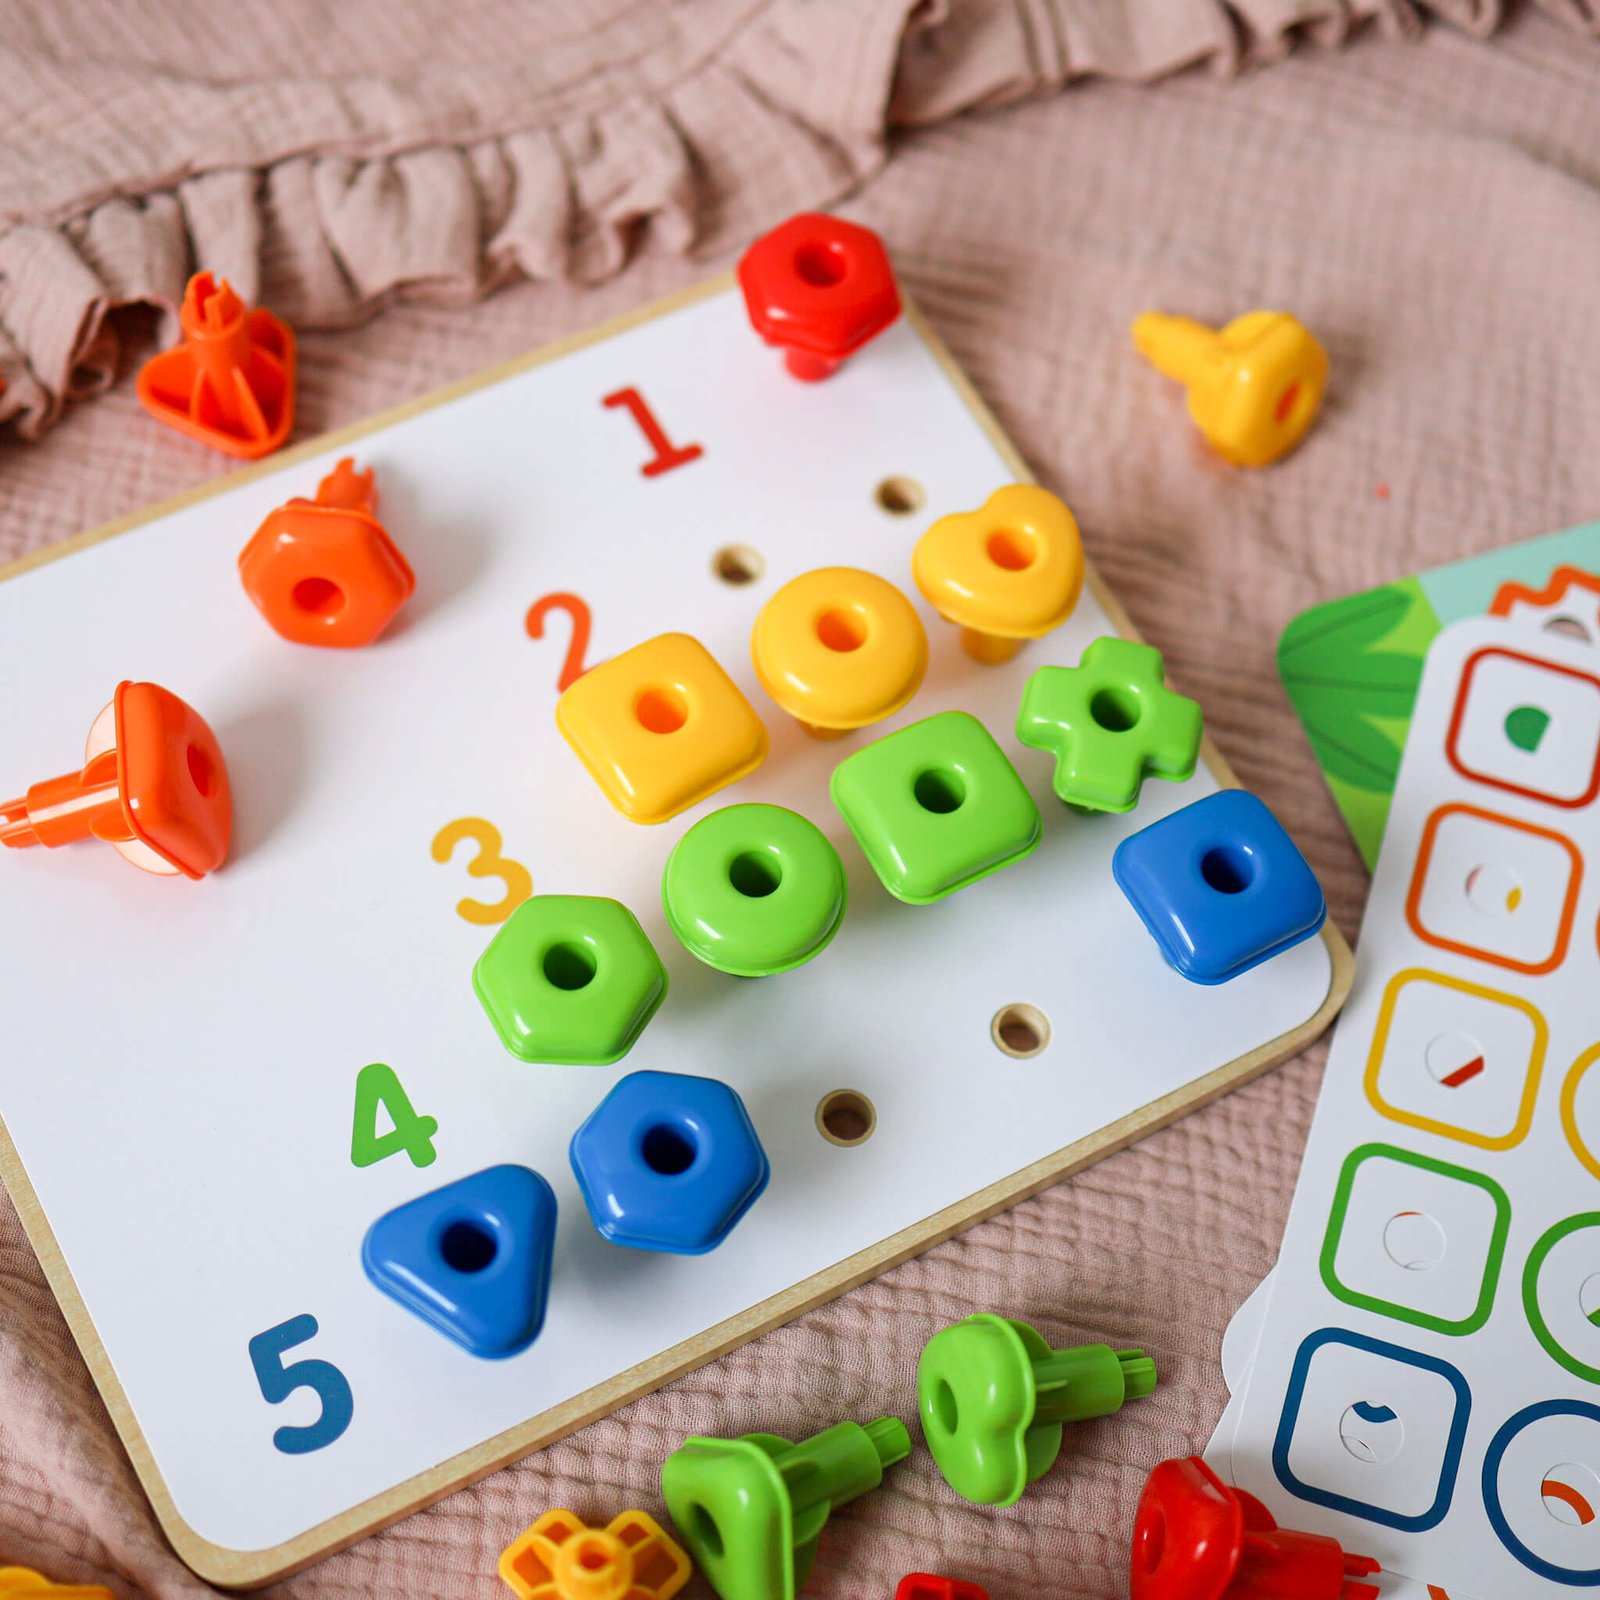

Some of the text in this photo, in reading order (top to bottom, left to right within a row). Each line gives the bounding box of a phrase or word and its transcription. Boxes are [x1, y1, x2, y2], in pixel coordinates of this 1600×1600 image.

[603, 387, 703, 477] 1
[525, 592, 598, 694] 2
[431, 817, 534, 925] 3
[352, 1063, 438, 1167] 4
[249, 1314, 353, 1454] 5
